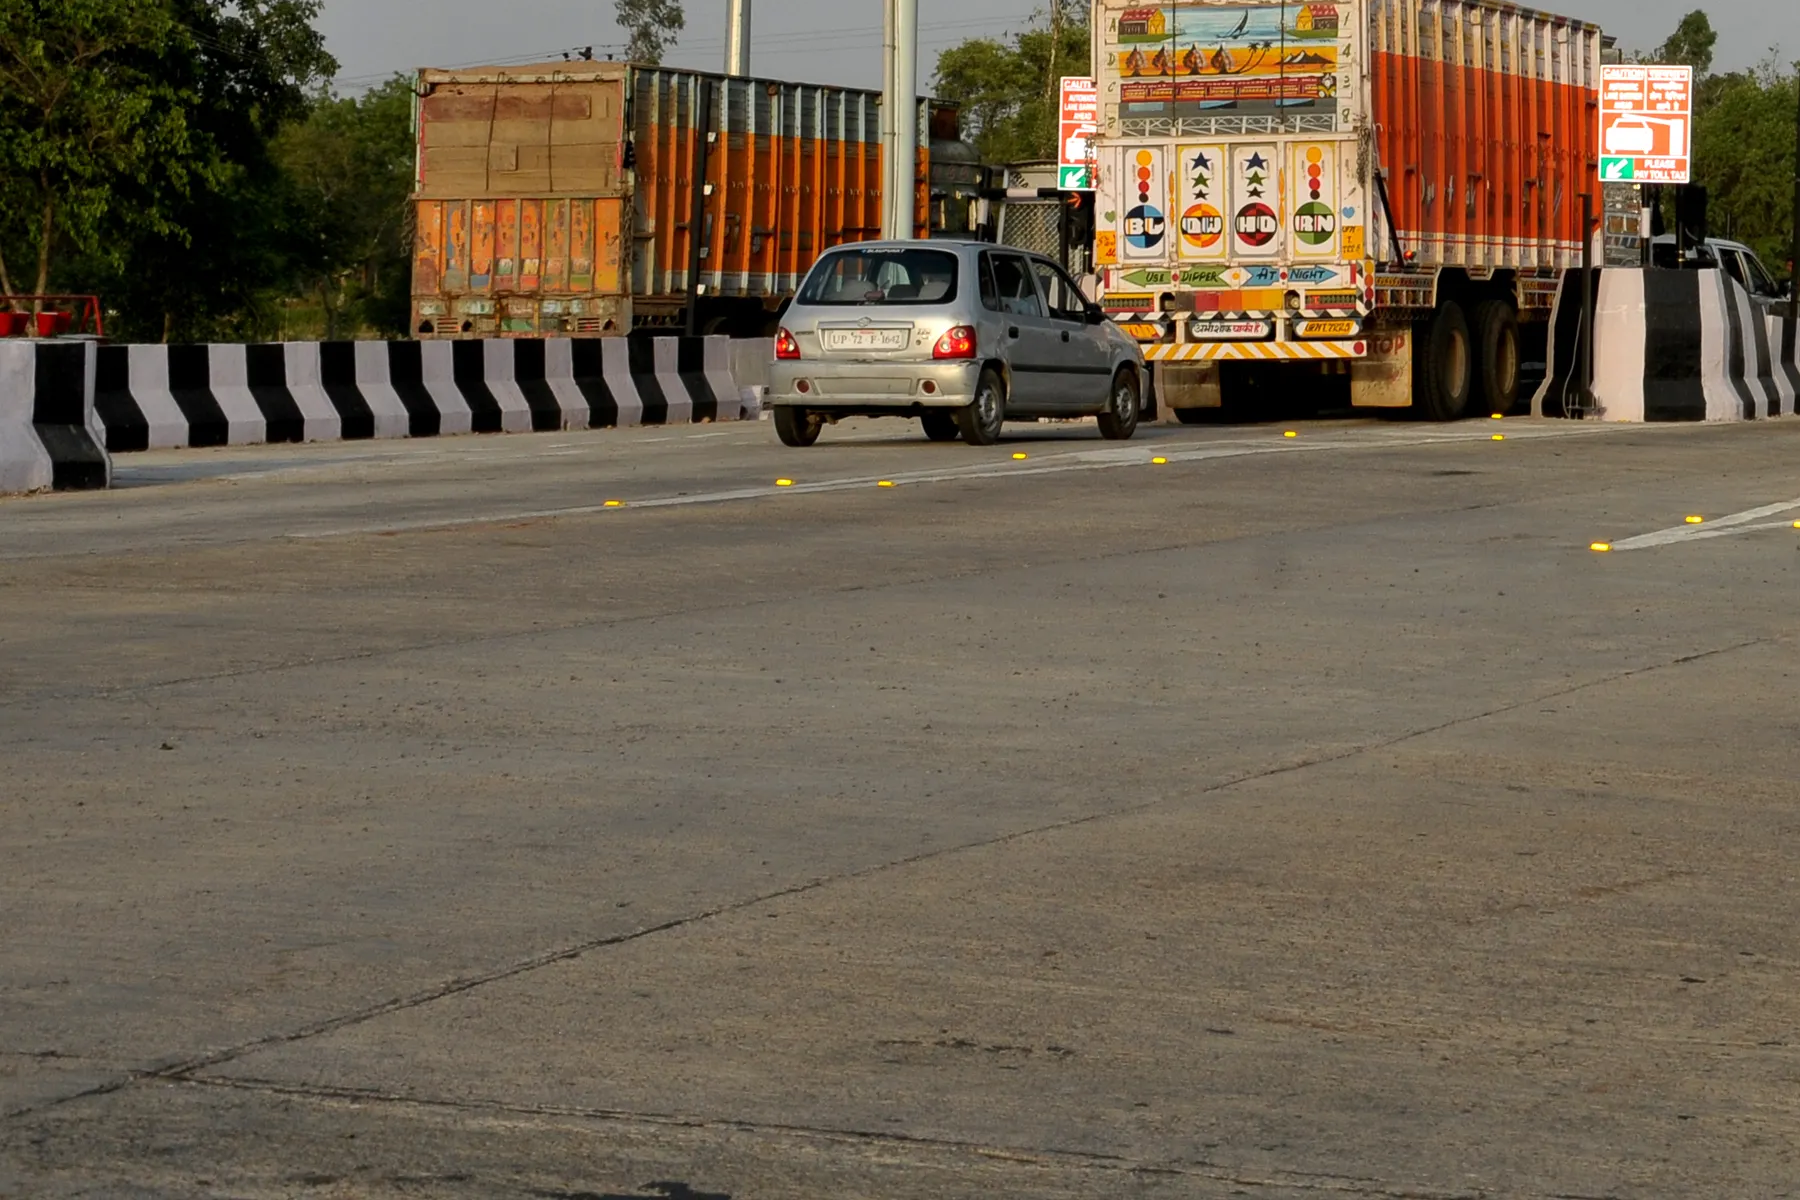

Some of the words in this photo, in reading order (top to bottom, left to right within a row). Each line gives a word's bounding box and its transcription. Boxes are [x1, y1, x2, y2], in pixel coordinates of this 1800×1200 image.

[1644, 159, 1676, 169] PLEASE
[1650, 170, 1669, 179] TOLL
[1671, 170, 1686, 180] TAX
[1146, 272, 1164, 282] USE
[1181, 271, 1218, 282] DIPPER
[1257, 269, 1277, 280] AT
[1289, 269, 1326, 280] NIGHT
